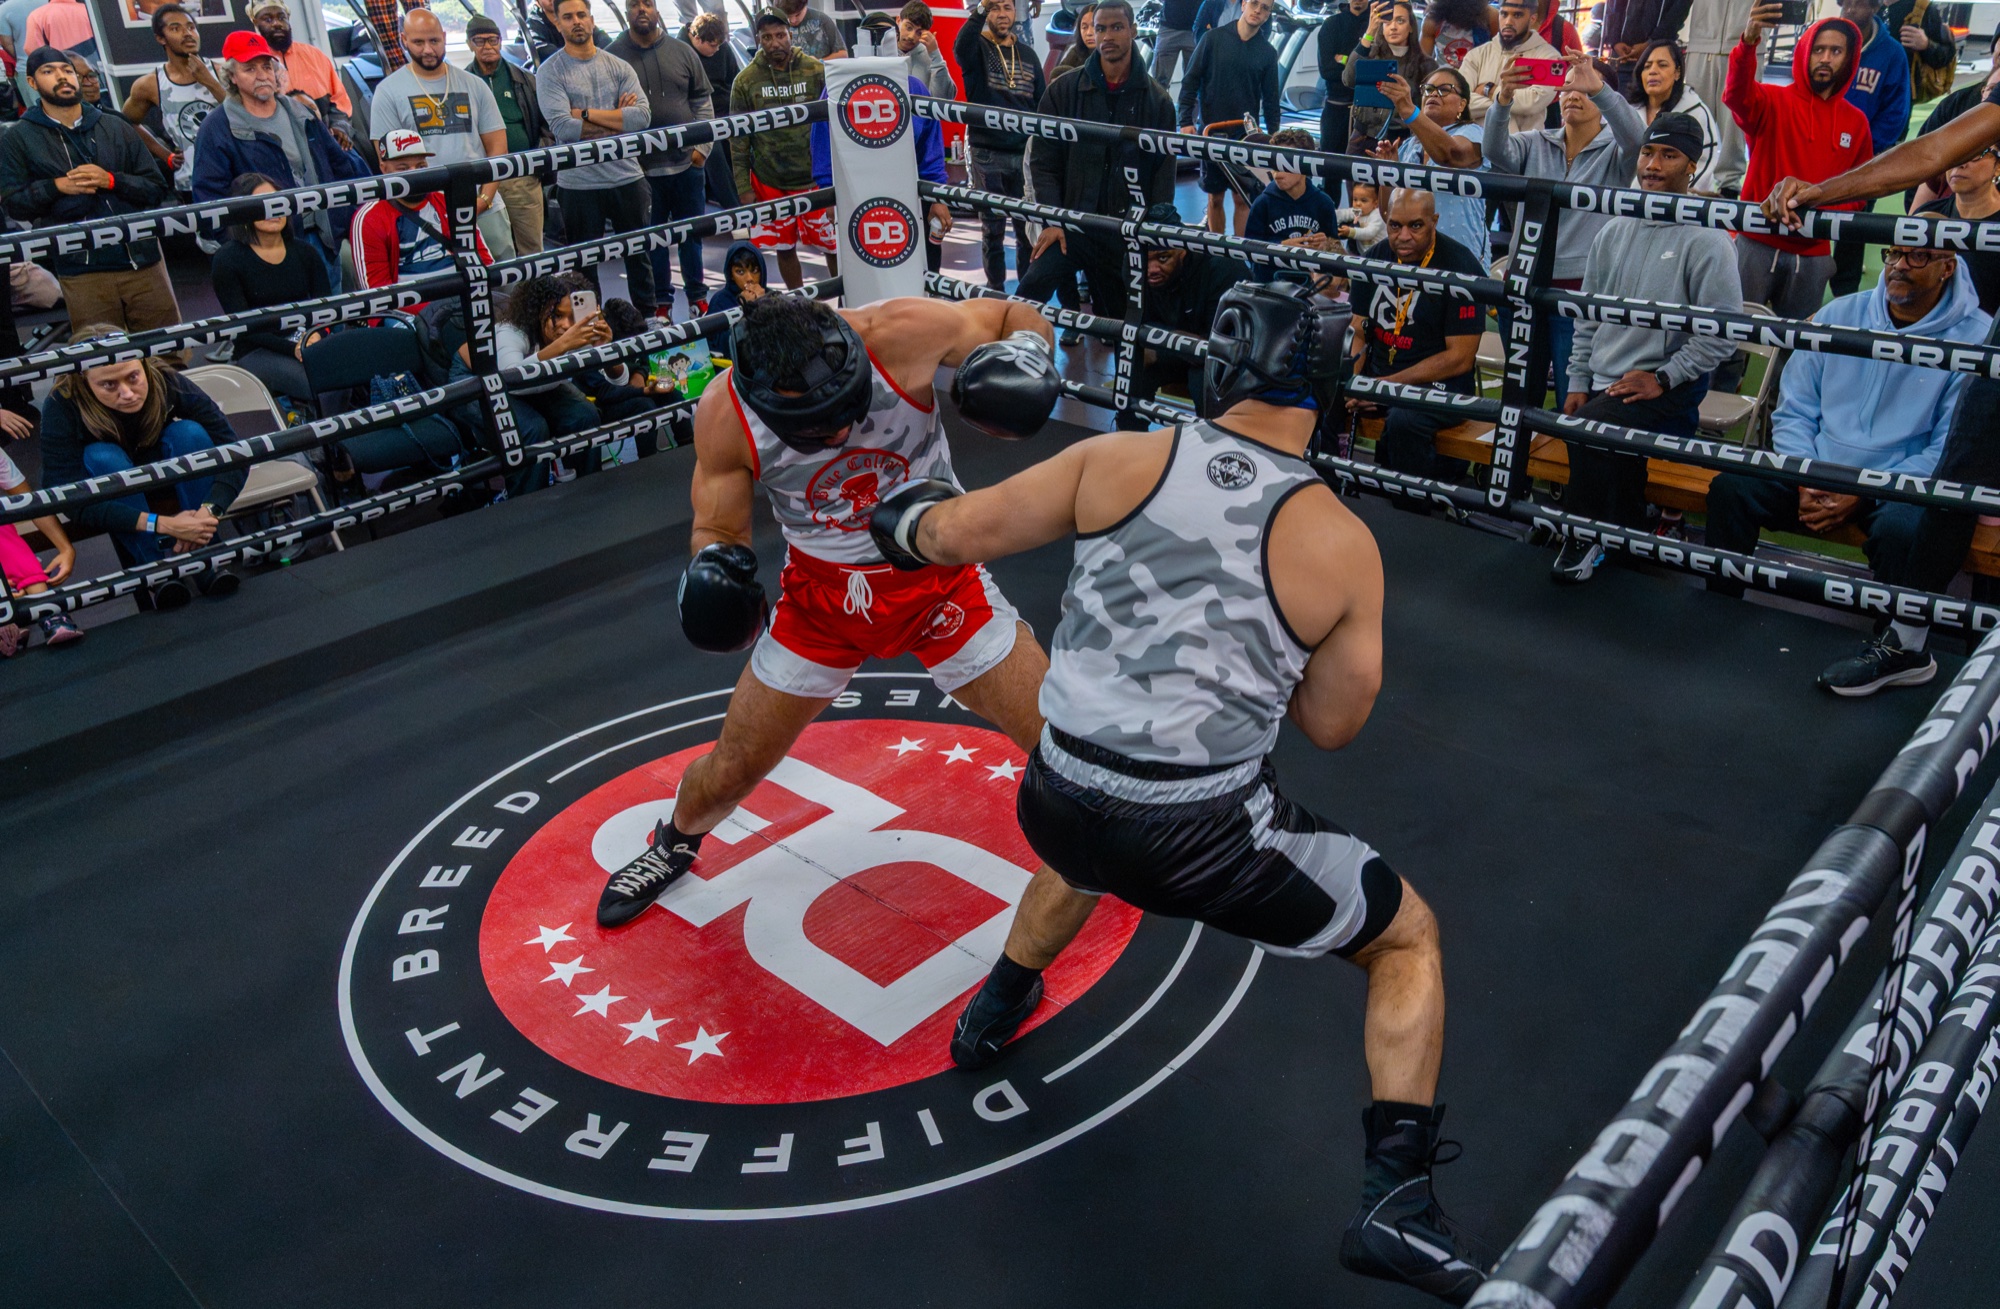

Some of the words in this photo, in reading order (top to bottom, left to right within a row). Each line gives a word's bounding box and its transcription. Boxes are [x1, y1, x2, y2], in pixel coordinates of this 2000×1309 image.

[761, 85, 789, 98] NEVER
[841, 77, 879, 106] DIFFERENT
[882, 80, 904, 103] BREED
[852, 99, 897, 124] DB
[489, 126, 687, 181] DIFFERENT
[711, 104, 809, 142] BREED
[984, 109, 1078, 143] BREED
[1139, 133, 1325, 177] DIFFERENT
[1352, 162, 1483, 198] BREED
[264, 177, 410, 220] BREED
[852, 200, 889, 227] DIFFERENT
[893, 203, 914, 225] BREED
[1269, 217, 1287, 234] LOS
[1288, 215, 1321, 233] ANGELES
[1570, 185, 1855, 241] DIFFERENT
[499, 224, 693, 288] DIFFERENT
[715, 195, 812, 236] BREED
[863, 221, 906, 245] DB
[1121, 166, 1146, 309] DIFFERENT
[455, 206, 495, 356] DIFFERENT
[518, 317, 702, 381] DIFFERENT
[1114, 323, 1138, 411] BREED
[309, 387, 446, 439] BREED
[1350, 374, 1479, 406] BREED
[482, 372, 524, 467] BREED
[1487, 405, 1521, 509] BREED
[656, 844, 671, 860] NIKE
[392, 790, 541, 982] BREED
[403, 1020, 1031, 1175] DIFFERENT
